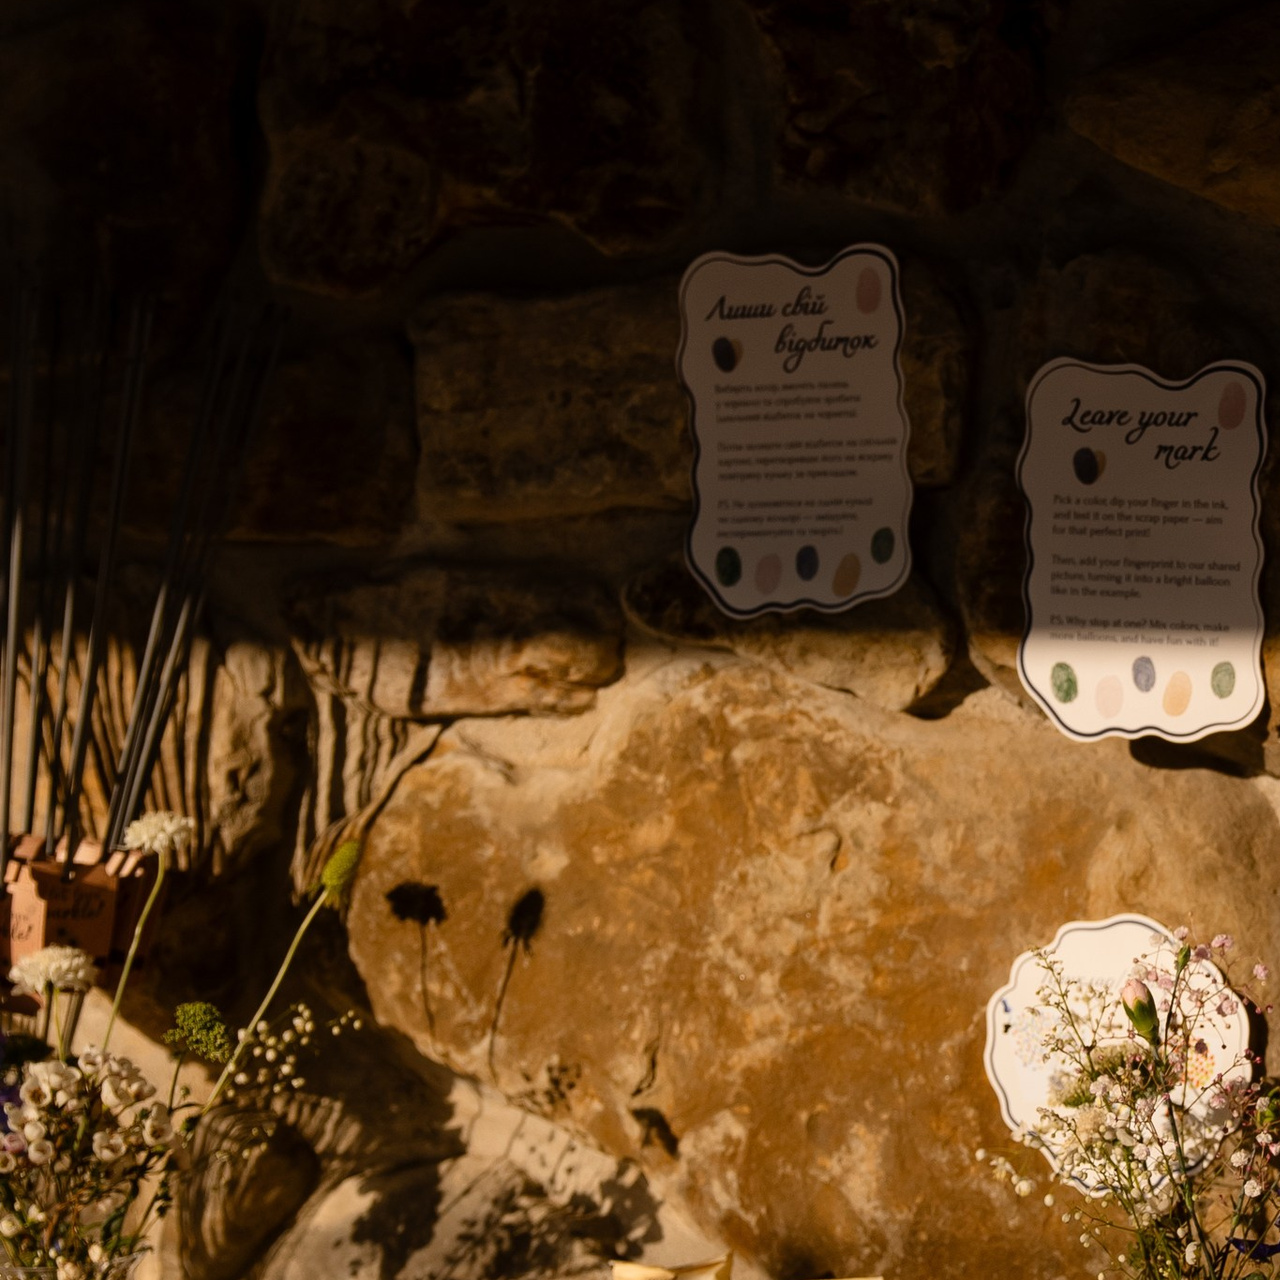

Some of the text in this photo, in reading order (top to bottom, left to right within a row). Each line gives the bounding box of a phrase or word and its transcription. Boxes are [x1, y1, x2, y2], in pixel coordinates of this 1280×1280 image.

[781, 285, 829, 317] свій
[774, 320, 879, 374] відбиток
[1061, 397, 1199, 445] Leave your
[1154, 426, 1221, 470] mark
[1110, 496, 1125, 508] dip
[1127, 499, 1149, 508] your
[1151, 497, 1179, 510] finger
[1182, 498, 1191, 508] in
[1194, 499, 1209, 508] the
[1053, 511, 1071, 520] and
[1102, 513, 1115, 521] on
[1117, 512, 1132, 522] the
[1135, 514, 1160, 525] scrap
[1162, 515, 1189, 526] paper
[1052, 525, 1066, 535] for
[1068, 526, 1087, 536] that
[1089, 526, 1122, 538] perfect
[1079, 556, 1097, 566] add
[1099, 558, 1121, 569] your
[1123, 557, 1173, 570] fingerprint
[1176, 560, 1186, 569] to
[1189, 562, 1205, 570] our
[1207, 561, 1241, 572] shared
[1134, 574, 1153, 583] into
[1164, 575, 1194, 587] bright
[1195, 576, 1230, 586] balloon
[1070, 586, 1079, 595] in
[1082, 587, 1097, 596] the
